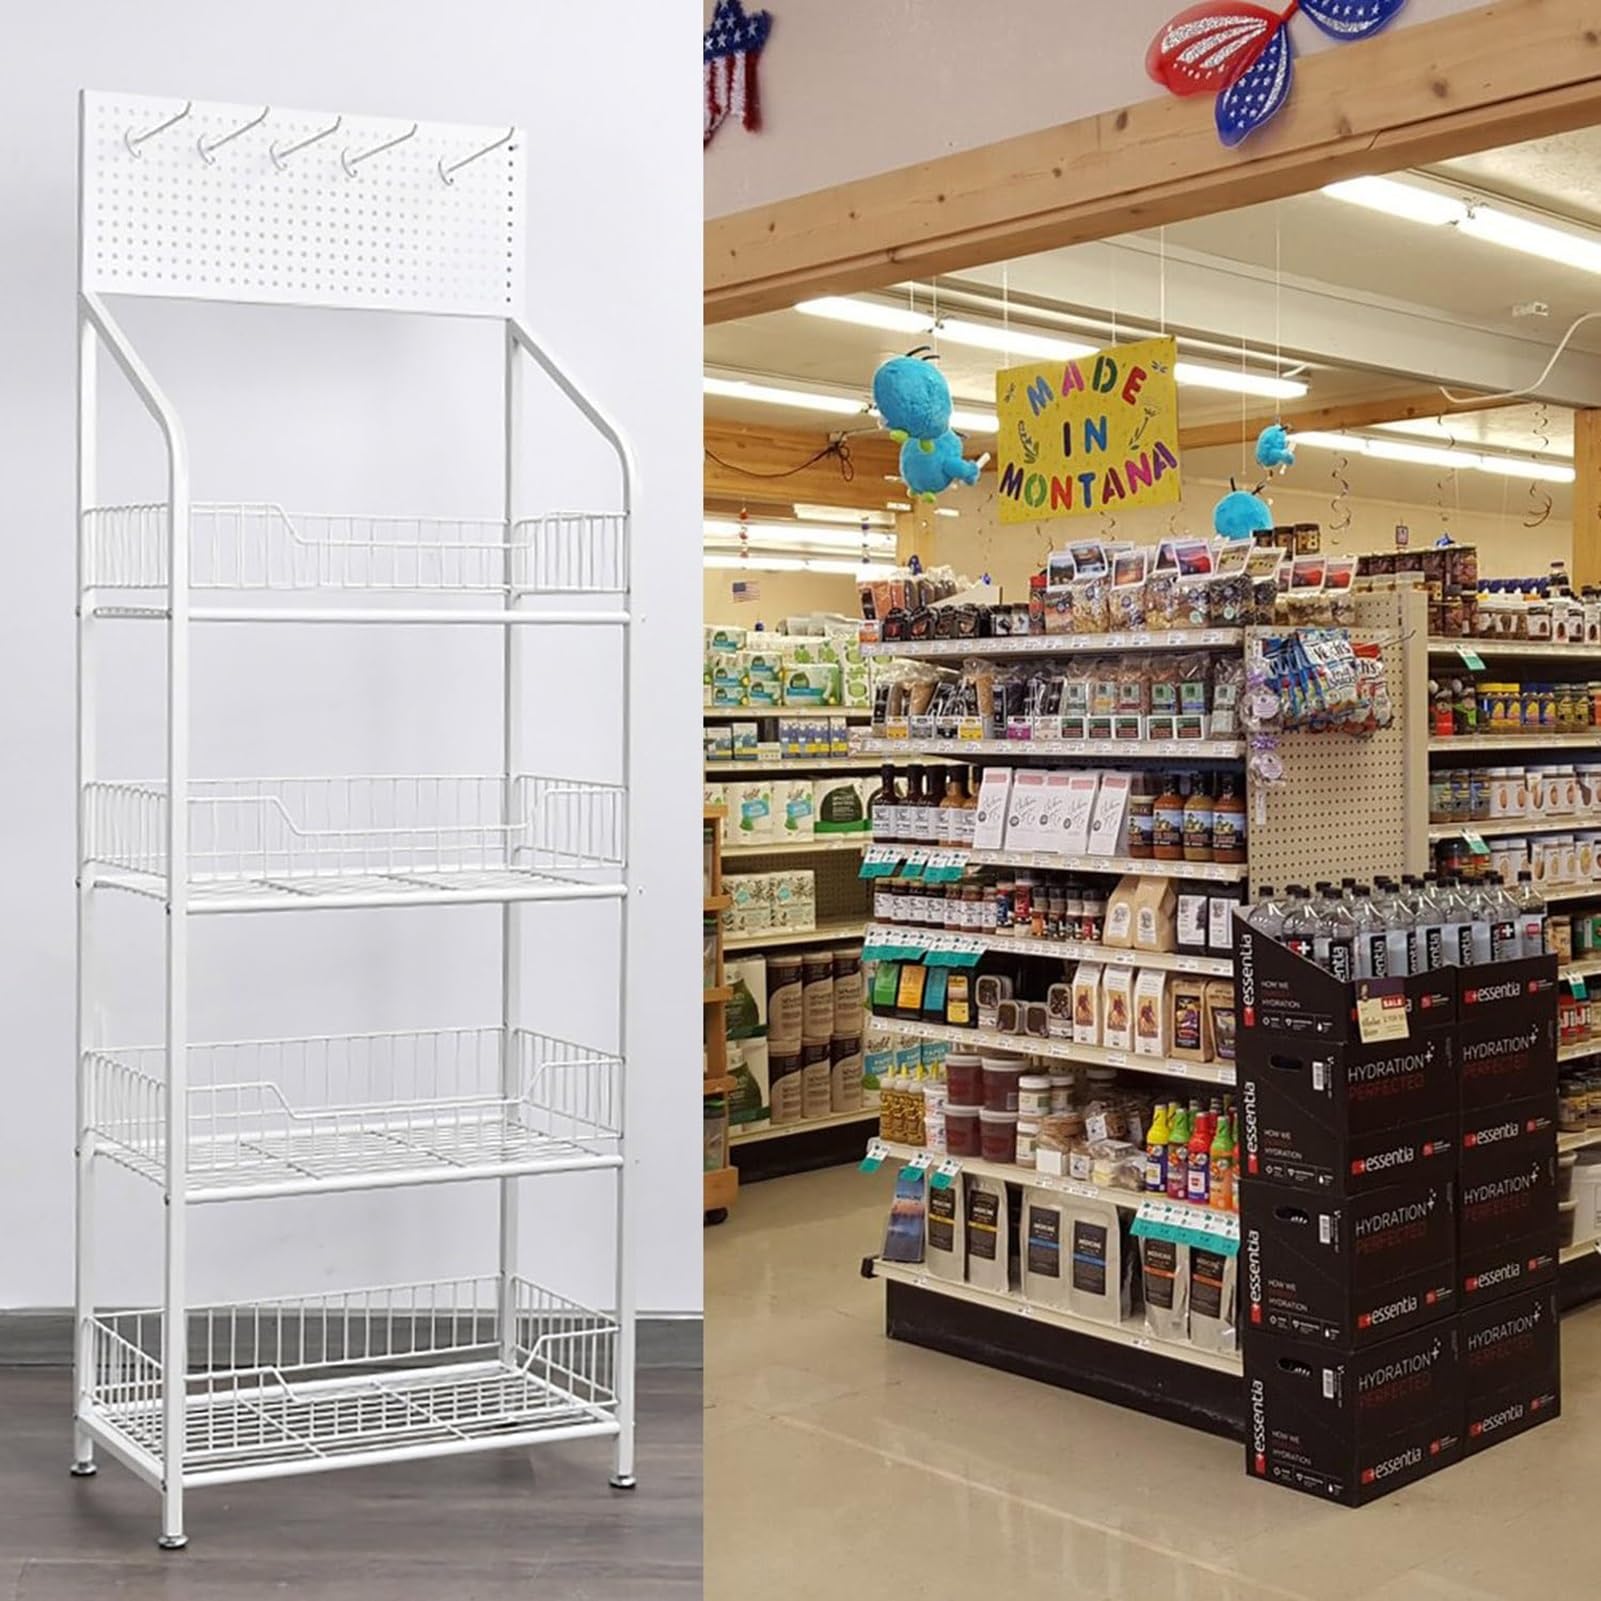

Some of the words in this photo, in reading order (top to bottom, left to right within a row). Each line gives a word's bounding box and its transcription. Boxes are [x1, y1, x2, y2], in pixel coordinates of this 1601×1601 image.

[1026, 355, 1149, 416] MADE
[1062, 415, 1108, 457] IN
[998, 440, 1179, 510] MONTANA
[1242, 933, 1255, 1006] essentia
[1476, 980, 1521, 1003] essentia
[1462, 1036, 1530, 1062] HYDRATION
[1348, 1055, 1425, 1083] HYDRATION
[1244, 1081, 1257, 1153] essentia
[1476, 1121, 1519, 1145] essentia
[1365, 1145, 1414, 1173] essentia
[1464, 1176, 1531, 1206] HYDRATION
[1355, 1203, 1428, 1237] HYDRATION
[1249, 1230, 1262, 1303] essentia
[1478, 1261, 1520, 1287] essentia
[1370, 1295, 1417, 1326] essentia
[1468, 1315, 1534, 1350] HYDRATION
[1358, 1350, 1432, 1392] HYDRATION
[1253, 1380, 1265, 1452] essentia
[1482, 1403, 1524, 1432] essentia
[1375, 1446, 1422, 1479] essentia
